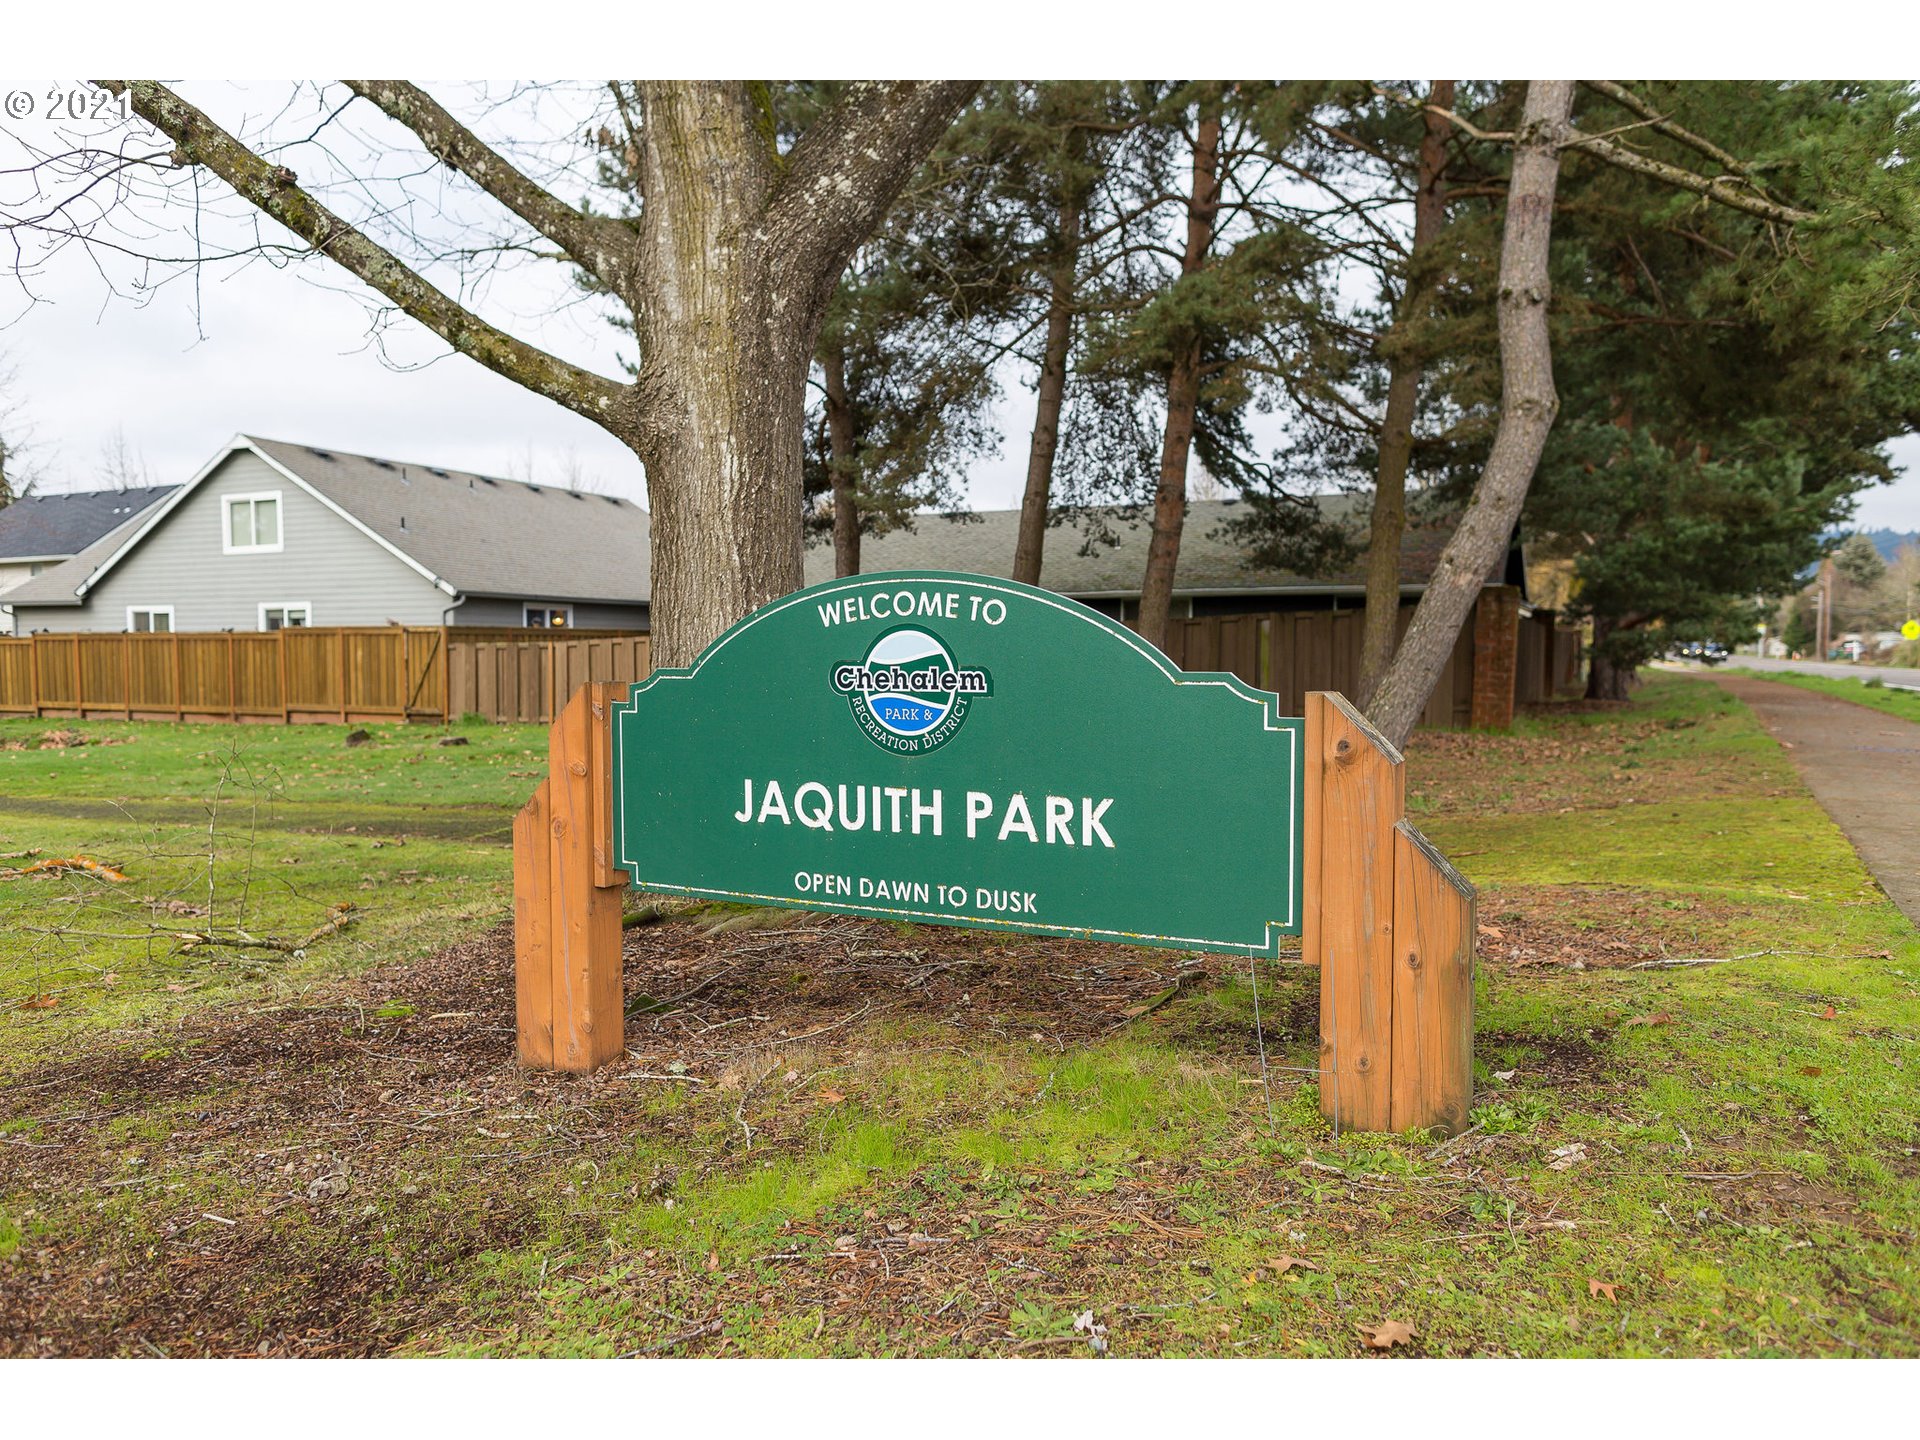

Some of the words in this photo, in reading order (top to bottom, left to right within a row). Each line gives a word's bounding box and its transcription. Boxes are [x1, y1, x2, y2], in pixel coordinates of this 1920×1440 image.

[817, 591, 960, 628] WELCOME
[969, 596, 1007, 626] TO
[834, 665, 988, 693] Chehalem
[852, 696, 919, 751] RECREATION
[922, 696, 968, 749] DISTRICT
[885, 708, 920, 720] PARK
[924, 708, 933, 721] &
[734, 778, 942, 836] JAQUITH
[966, 791, 1116, 848] PARK
[794, 871, 851, 896] OPEN
[859, 877, 929, 904] DAWN
[937, 884, 967, 907] TO
[976, 888, 1038, 914] DUSK
